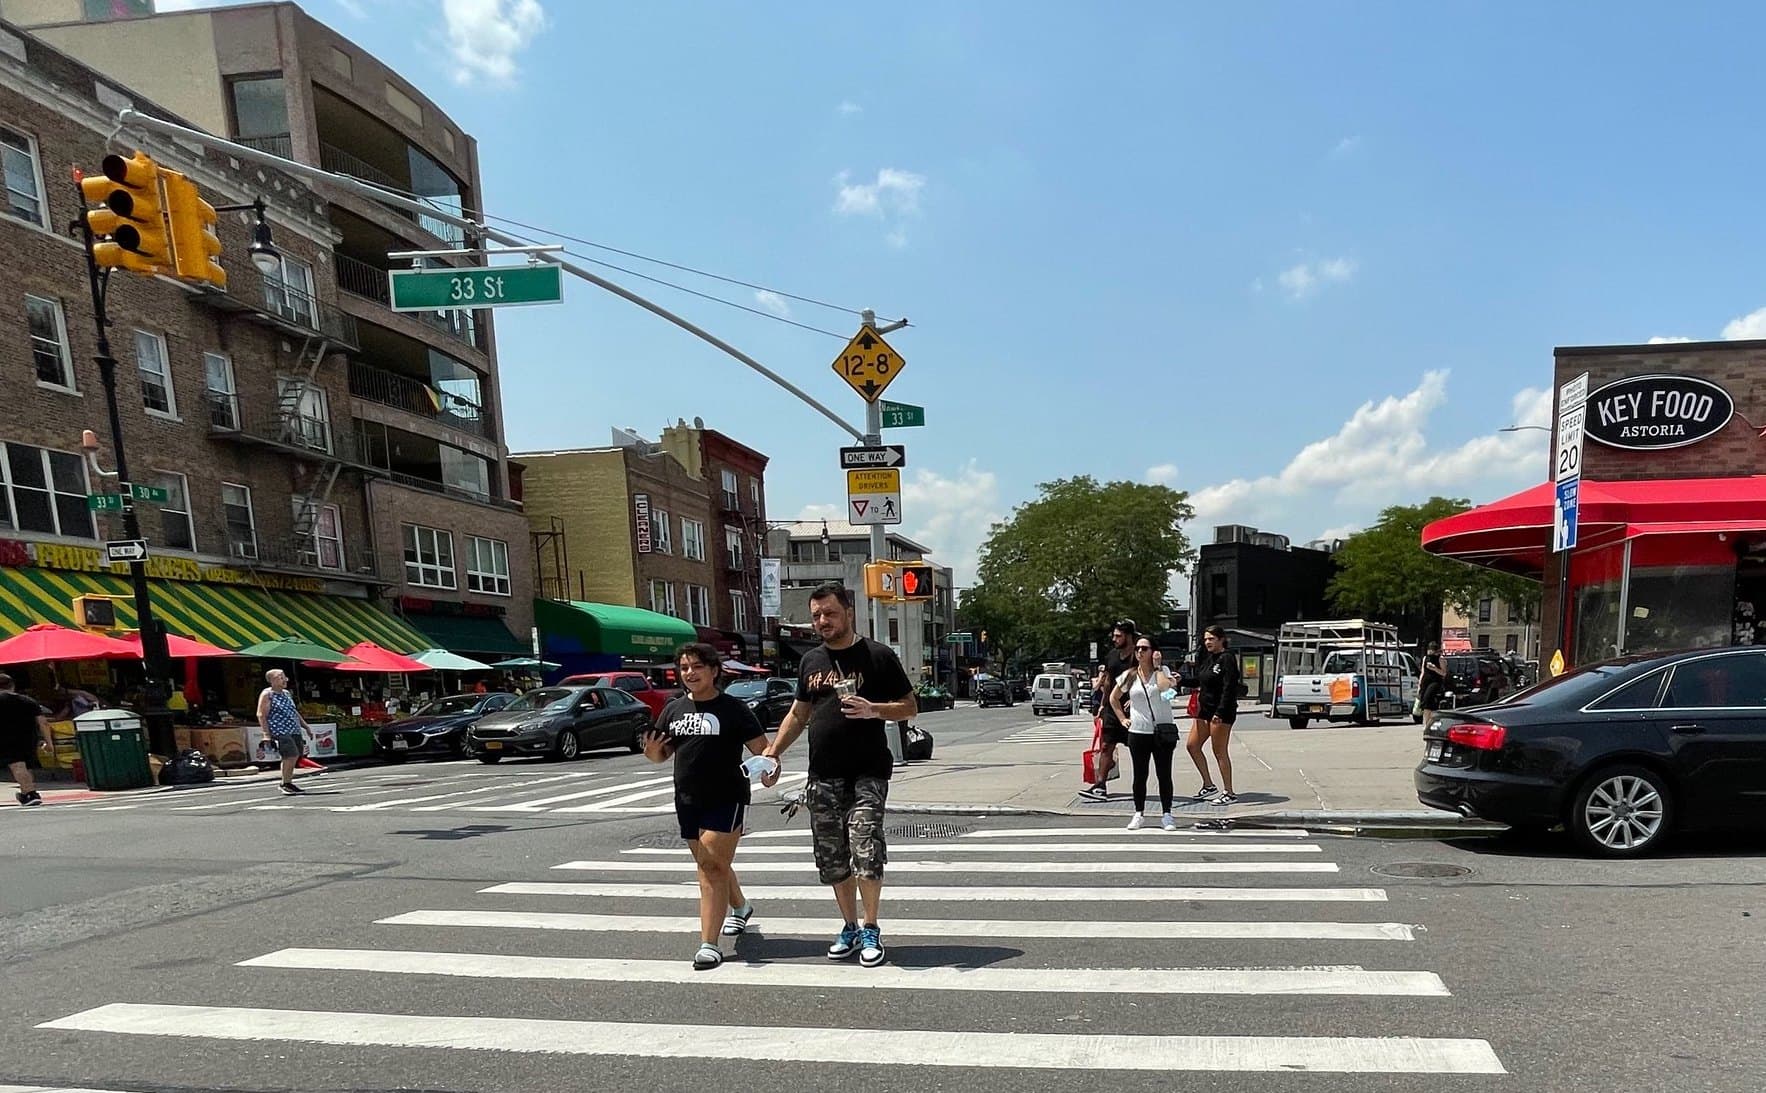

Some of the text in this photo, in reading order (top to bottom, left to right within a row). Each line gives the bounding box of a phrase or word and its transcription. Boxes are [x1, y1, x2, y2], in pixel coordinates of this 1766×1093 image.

[451, 276, 505, 300] 33 St
[1598, 390, 1713, 427] KEY FOOD
[891, 412, 904, 425] 33
[1561, 413, 1582, 431] SPEED
[1561, 428, 1580, 446] LIMIT
[1620, 424, 1686, 438] ASTORIA
[847, 452, 886, 462] ONE WAY
[1560, 444, 1578, 474] 20
[855, 472, 893, 481] ATTENTION
[138, 486, 150, 499] 30
[858, 482, 888, 490] DRIVERS
[96, 496, 107, 509] 33
[683, 712, 703, 721] THE
[669, 719, 702, 731] NORTH
[675, 726, 701, 736] FACE
